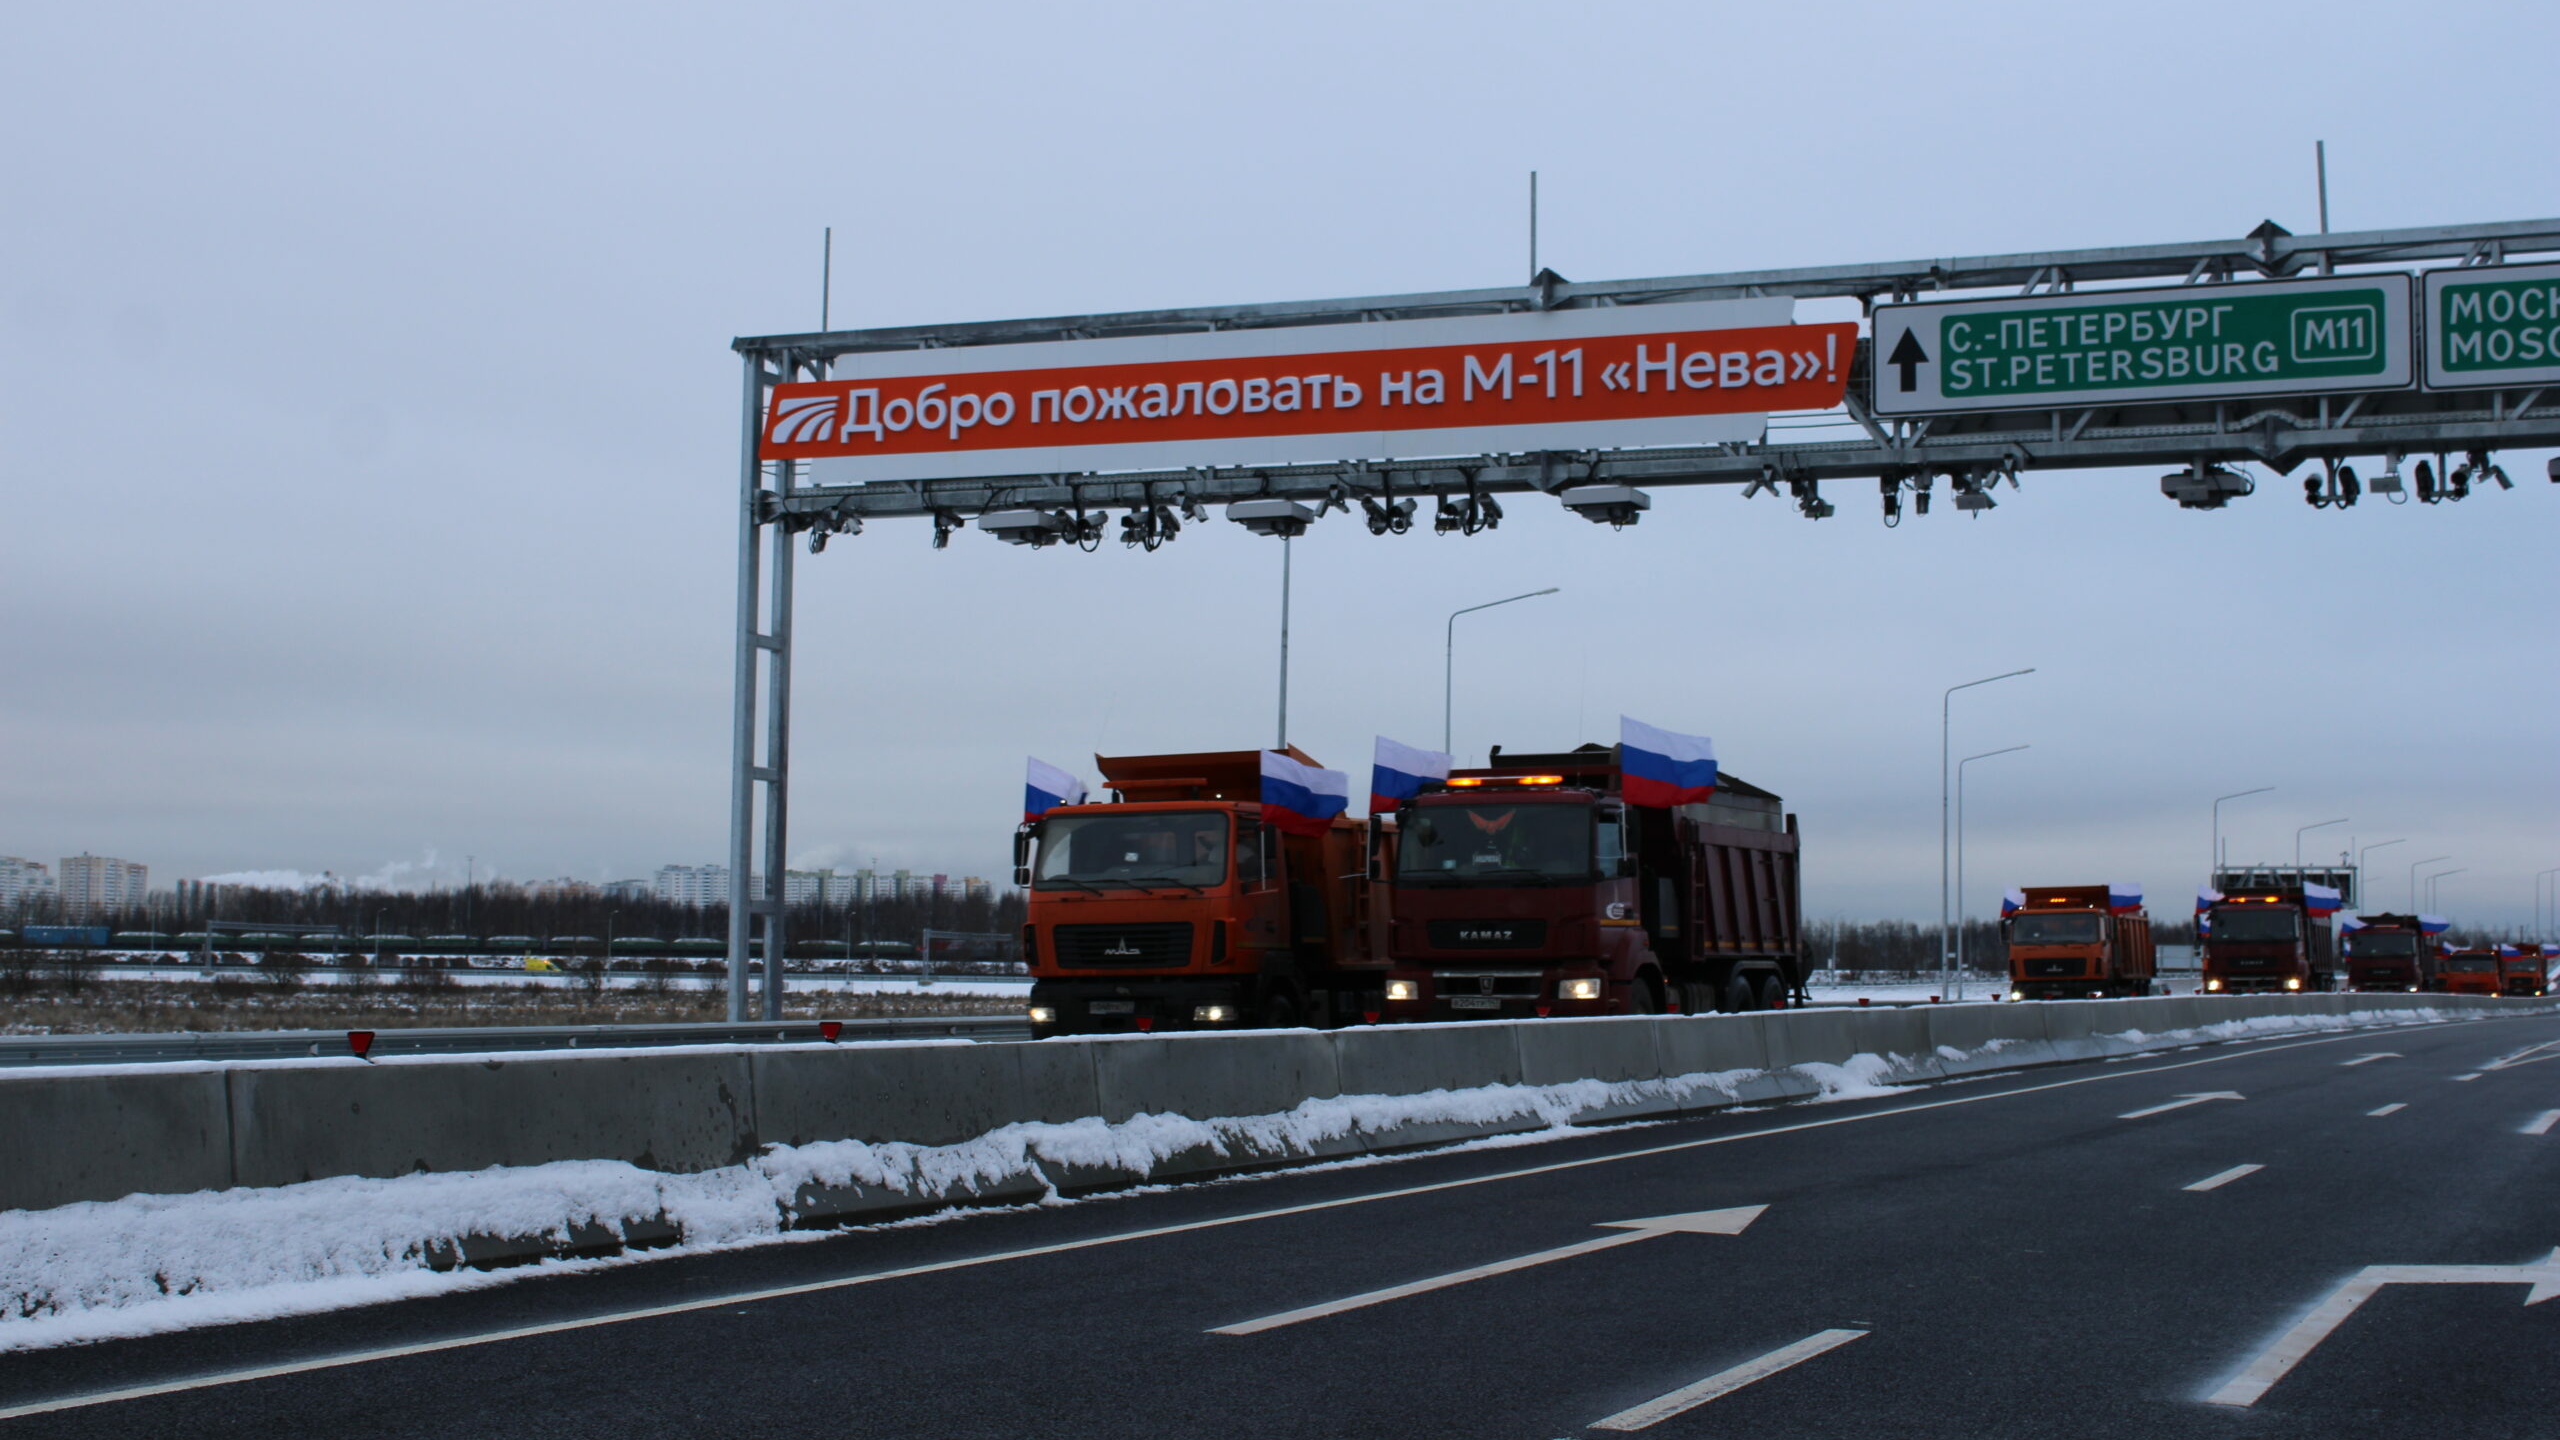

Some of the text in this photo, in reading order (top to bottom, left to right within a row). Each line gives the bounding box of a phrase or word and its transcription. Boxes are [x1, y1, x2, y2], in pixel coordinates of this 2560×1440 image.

[1949, 306, 2233, 353] С.-ПЕТЕРБУРГ
[2304, 316, 2364, 350] М11
[840, 333, 1837, 443] Добро пожаловать на М-11 «Нева»!
[1949, 341, 2279, 391] ST.PETERSBURG
[1460, 931, 1512, 940] KAMAZ
